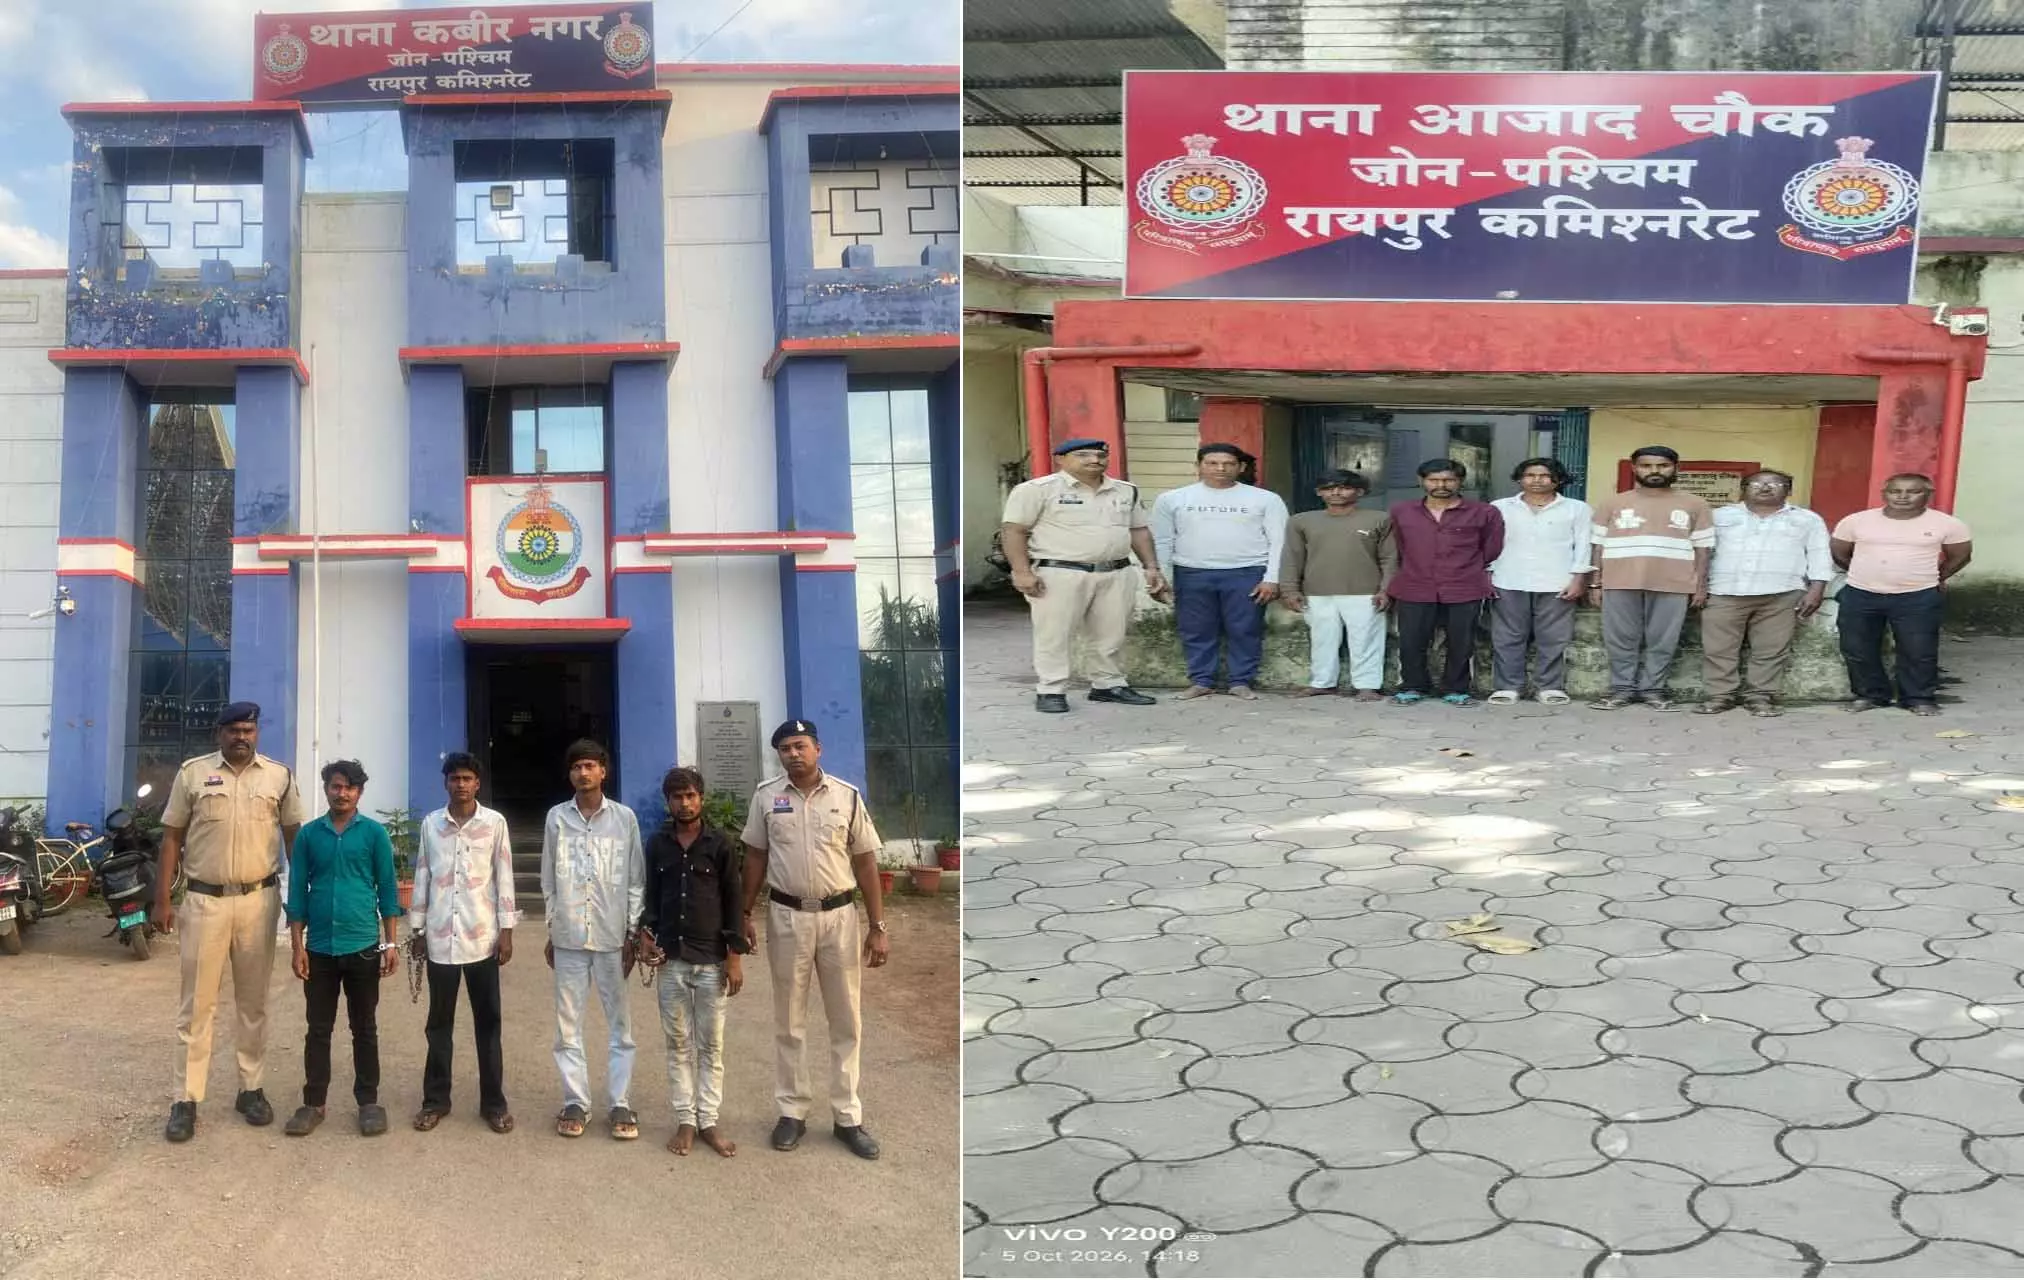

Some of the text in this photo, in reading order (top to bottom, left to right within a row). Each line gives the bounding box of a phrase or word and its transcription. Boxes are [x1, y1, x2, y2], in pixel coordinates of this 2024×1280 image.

[309, 10, 604, 47] थाना कबीर नगर
[368, 69, 532, 96] रायपुर कमिश्नरेट
[1223, 90, 1835, 139] थाना आजाद चौक
[1283, 195, 1760, 251] रायपुर कमिश्नरेट
[1187, 505, 1249, 514] FUTURE
